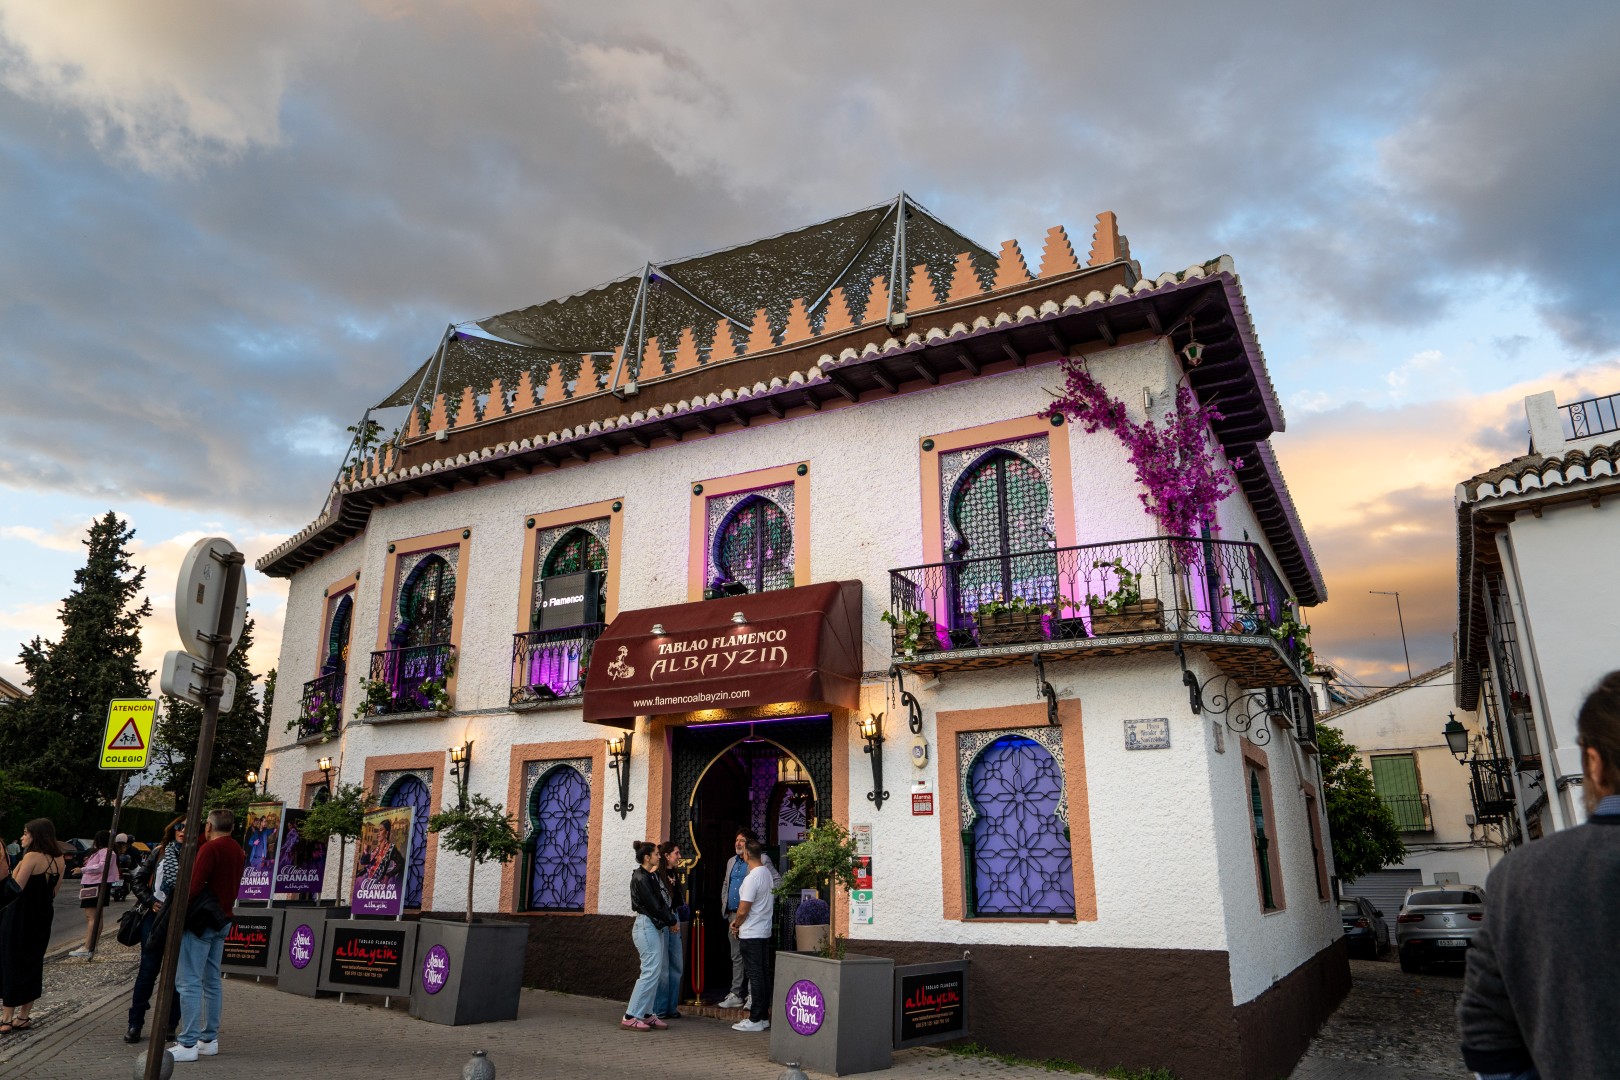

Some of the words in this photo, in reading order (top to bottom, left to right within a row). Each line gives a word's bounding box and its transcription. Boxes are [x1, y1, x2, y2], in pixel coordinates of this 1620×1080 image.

[549, 595, 584, 607] Flamenco
[658, 639, 708, 655] TABLAO
[711, 629, 787, 649] FLAMENCO
[650, 646, 788, 681] ALBAYZIN
[633, 689, 750, 708] www.flamencoalbayzin.com
[113, 704, 154, 712] ATENCIÓN
[105, 755, 143, 763] COLEGIO
[240, 876, 270, 886] GRANADA
[276, 874, 319, 882] GRANADA
[356, 889, 398, 900] GRANADA
